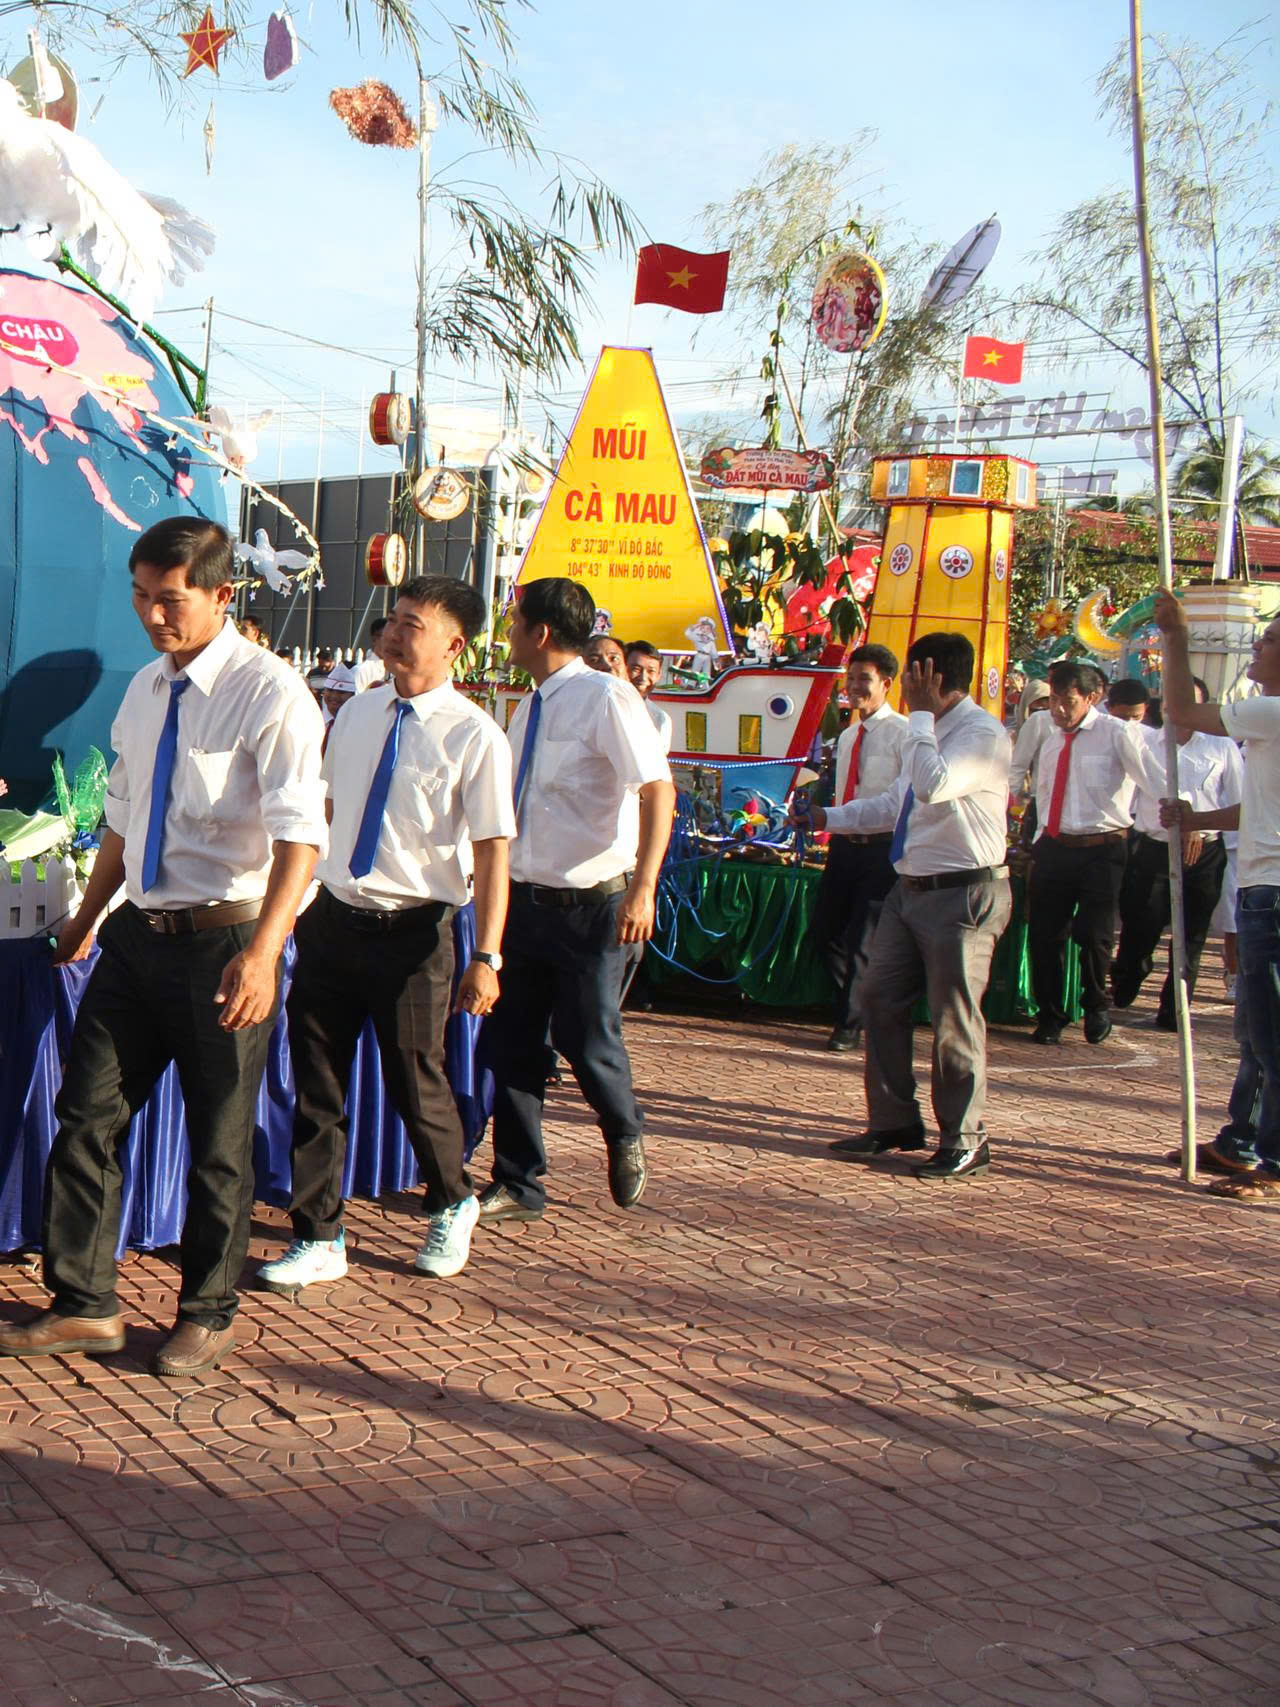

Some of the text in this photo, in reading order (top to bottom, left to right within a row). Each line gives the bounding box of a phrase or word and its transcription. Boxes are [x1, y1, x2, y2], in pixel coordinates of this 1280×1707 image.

[1, 321, 64, 342] CHÂU
[593, 422, 646, 461] MŨI
[748, 469, 767, 482] MŨI
[769, 470, 782, 483] CÀ
[785, 473, 809, 486] MAU
[565, 482, 677, 525] CÀ MAU
[629, 538, 642, 558] ĐỘ
[645, 536, 663, 556] BẮC
[608, 563, 629, 578] KINH
[632, 561, 645, 580] ĐỘ
[647, 562, 672, 580] ĐÔNG
